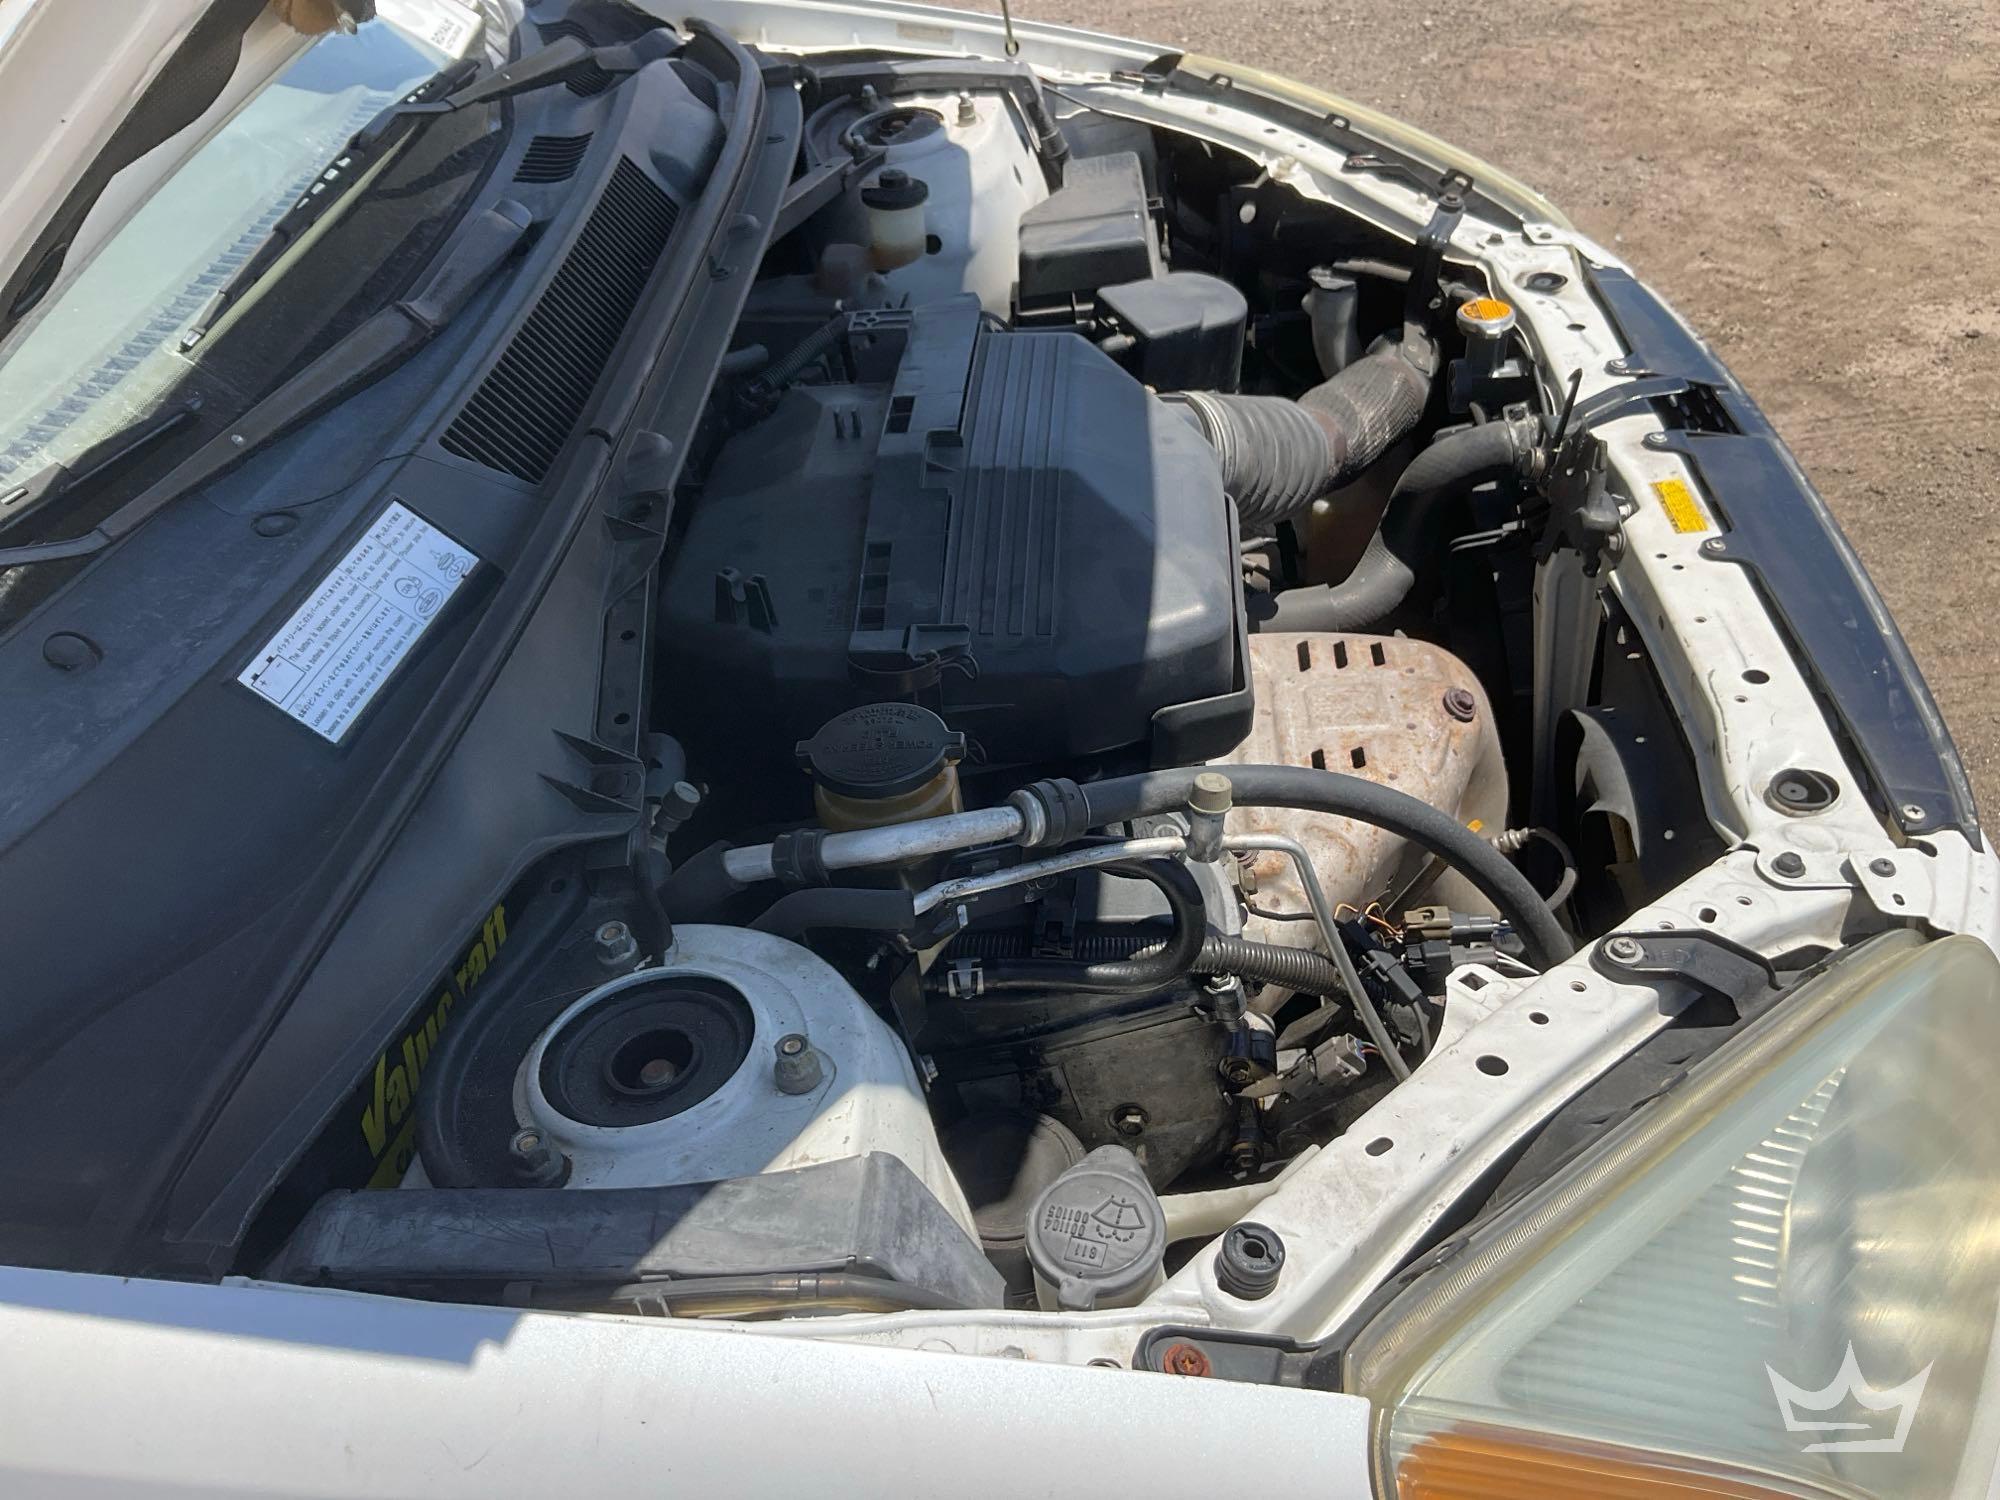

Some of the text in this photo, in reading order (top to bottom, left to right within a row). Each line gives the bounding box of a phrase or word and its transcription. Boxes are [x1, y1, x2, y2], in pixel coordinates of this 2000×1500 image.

[356, 569, 370, 583] Turn
[287, 650, 301, 663] The
[295, 635, 315, 654] battery
